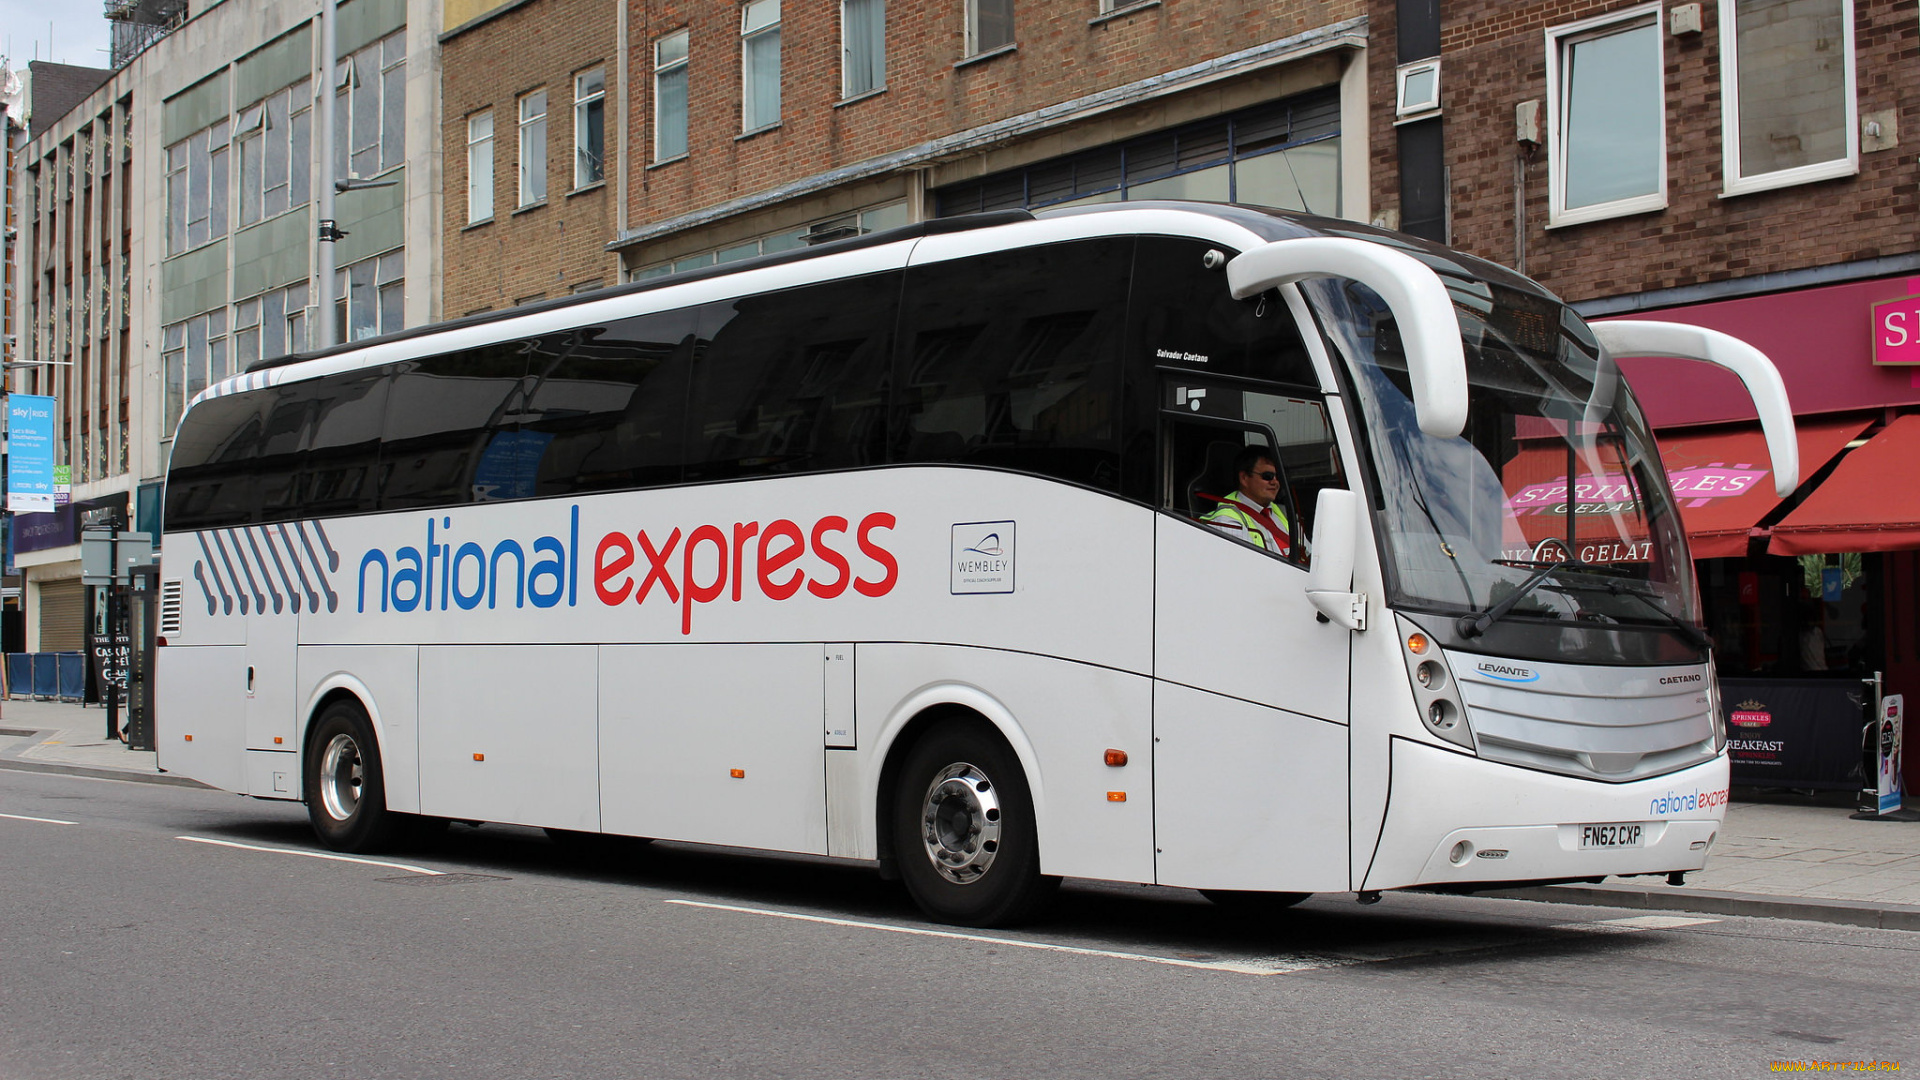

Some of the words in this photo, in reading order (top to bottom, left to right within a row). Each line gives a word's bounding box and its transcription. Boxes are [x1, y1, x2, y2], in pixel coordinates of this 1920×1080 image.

[1156, 349, 1183, 360] Salvador
[1183, 351, 1209, 363] Caetano
[12, 407, 29, 418] sky
[35, 482, 49, 490] sky
[1515, 474, 1753, 503] SPRINLES
[357, 504, 580, 614] national
[593, 511, 899, 636] express
[957, 560, 1008, 573] WEMBLEY
[1477, 662, 1530, 678] LEVANTE
[1659, 674, 1701, 685] CAETANO
[1650, 788, 1698, 815] national
[1583, 826, 1616, 847] FN62
[1618, 825, 1641, 845] CXP
